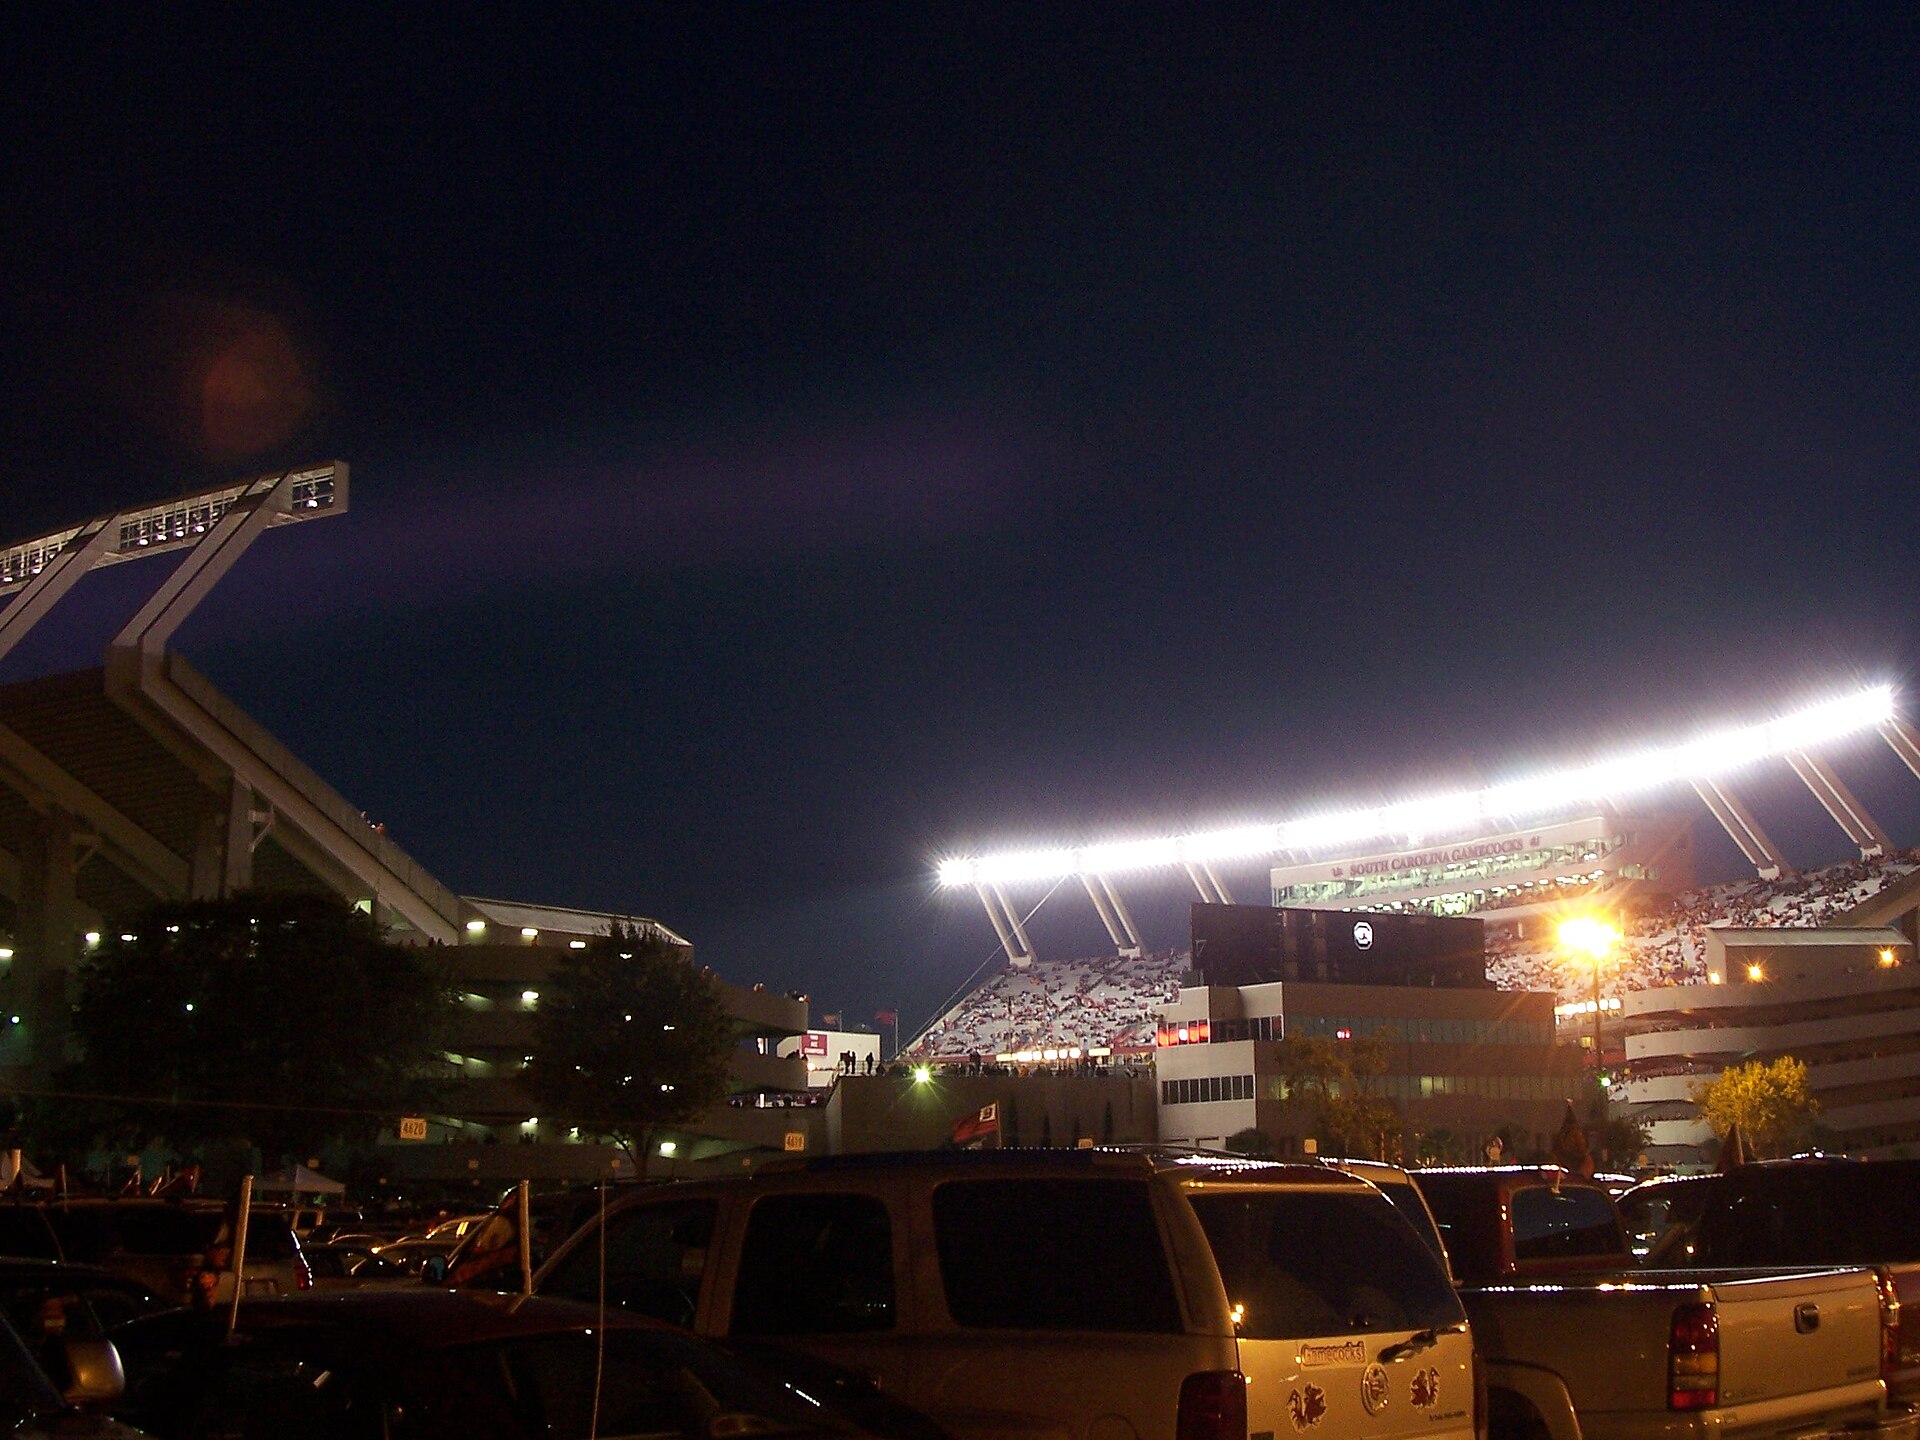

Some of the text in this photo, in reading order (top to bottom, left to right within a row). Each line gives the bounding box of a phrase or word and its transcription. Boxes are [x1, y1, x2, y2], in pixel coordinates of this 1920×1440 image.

[1350, 838, 1524, 876] SOUTH CAROLINA GAMECOCKS
